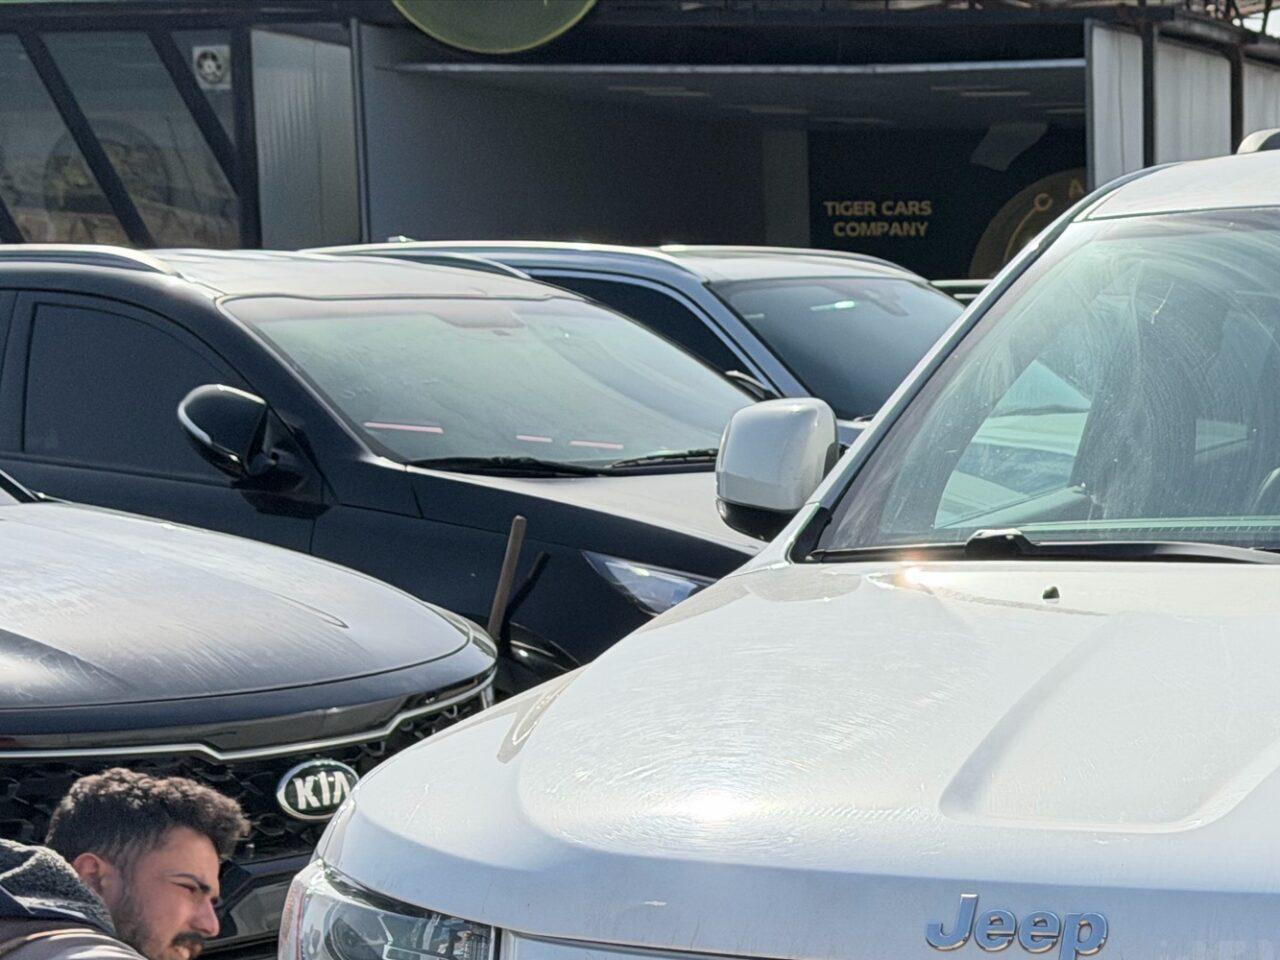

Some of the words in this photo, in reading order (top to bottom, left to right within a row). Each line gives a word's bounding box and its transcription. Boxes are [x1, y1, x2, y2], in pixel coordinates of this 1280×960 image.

[823, 200, 877, 217] TIGER
[880, 200, 933, 217] CARS
[832, 220, 929, 238] COMPANY
[292, 770, 353, 810] KIA
